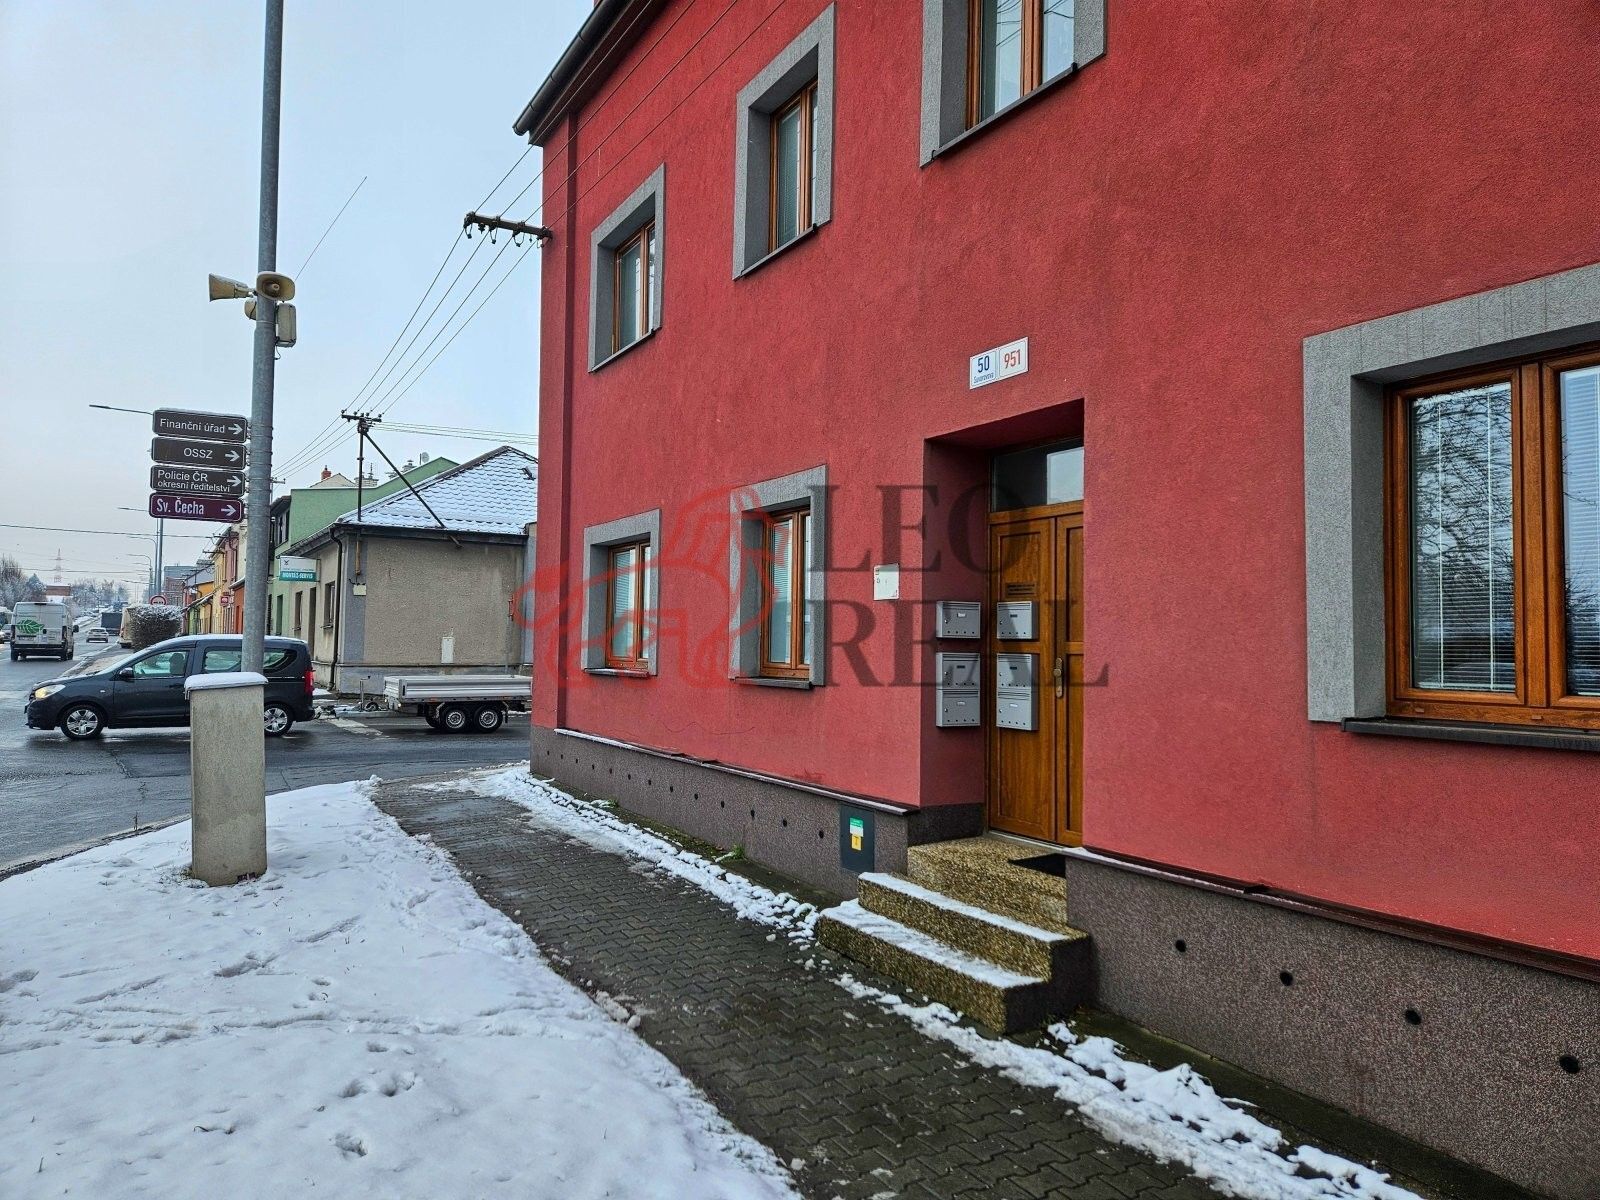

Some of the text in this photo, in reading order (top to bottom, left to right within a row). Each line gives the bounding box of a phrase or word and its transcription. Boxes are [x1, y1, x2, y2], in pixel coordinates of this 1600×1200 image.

[978, 349, 1021, 373] 50 951
[160, 418, 225, 433] Finanční úřad
[183, 447, 213, 459] OSSZ
[157, 470, 208, 482] Policie ČR
[157, 480, 230, 492] okresní ředitelství
[156, 496, 204, 514] Sv. Čecha
